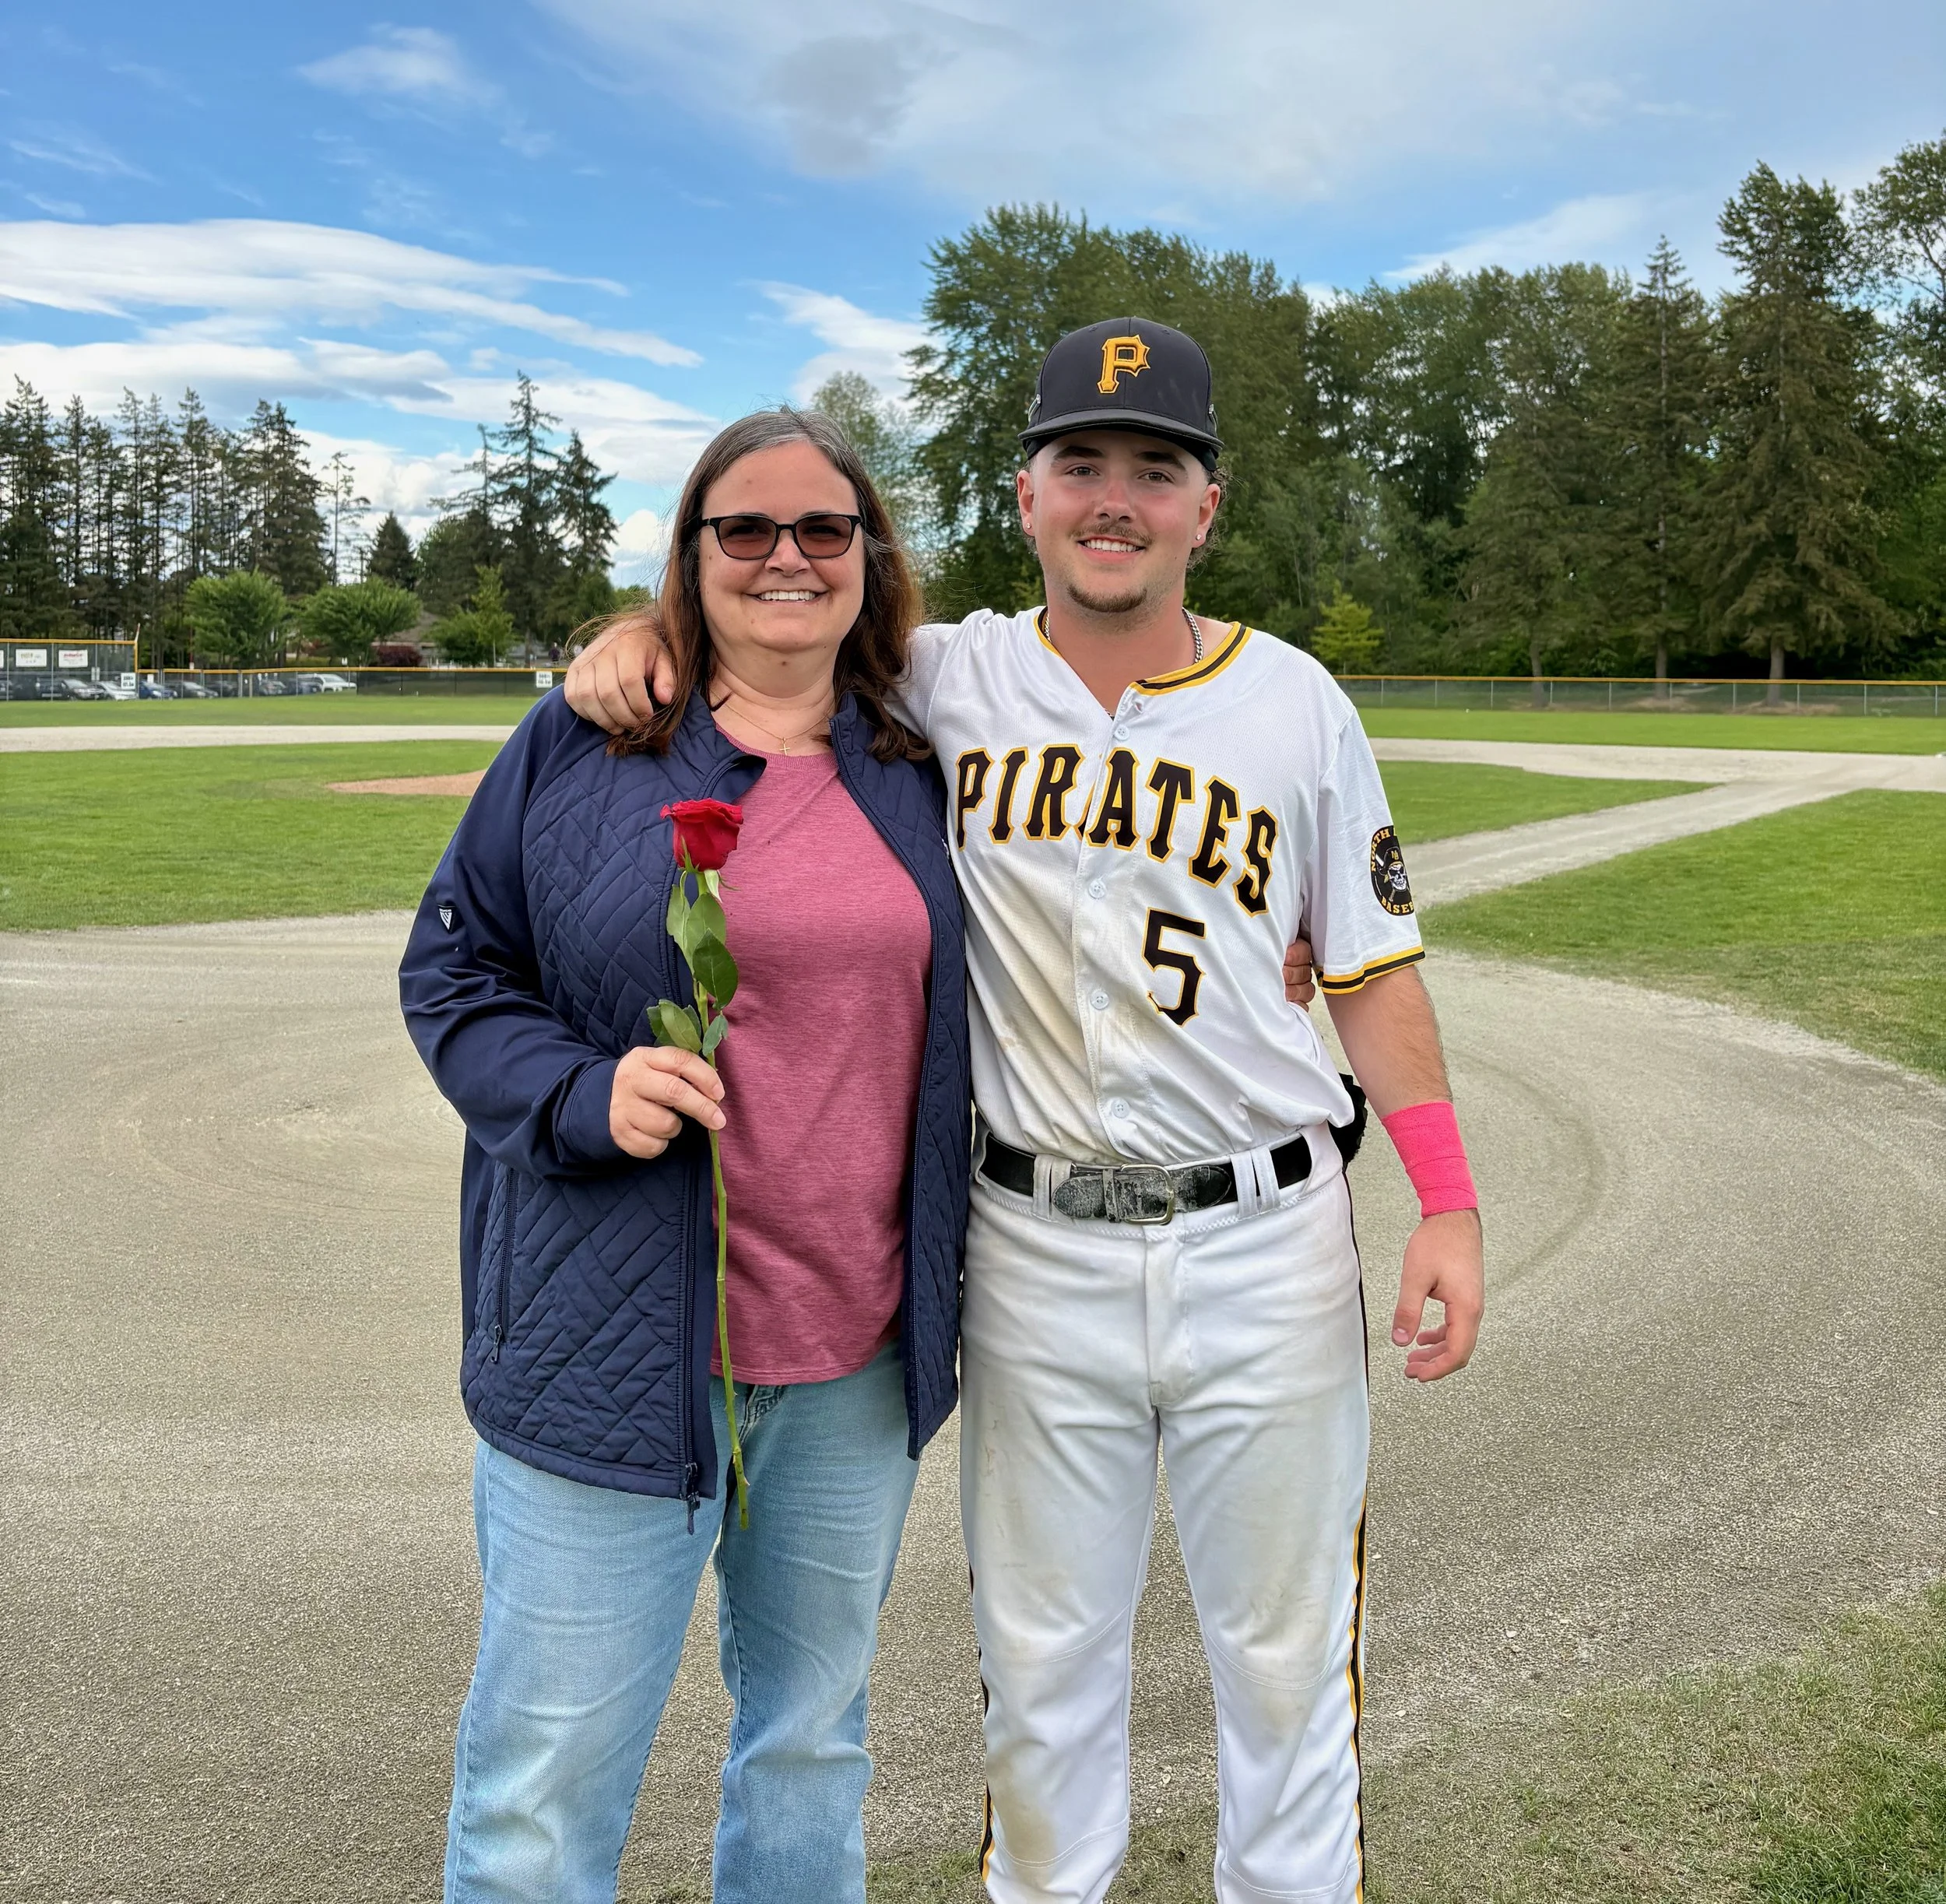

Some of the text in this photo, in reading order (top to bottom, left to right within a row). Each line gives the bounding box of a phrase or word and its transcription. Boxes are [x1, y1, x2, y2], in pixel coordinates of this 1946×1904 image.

[1097, 334, 1150, 394] P
[956, 743, 1279, 917] PIRATES
[1142, 907, 1206, 1027] 5
